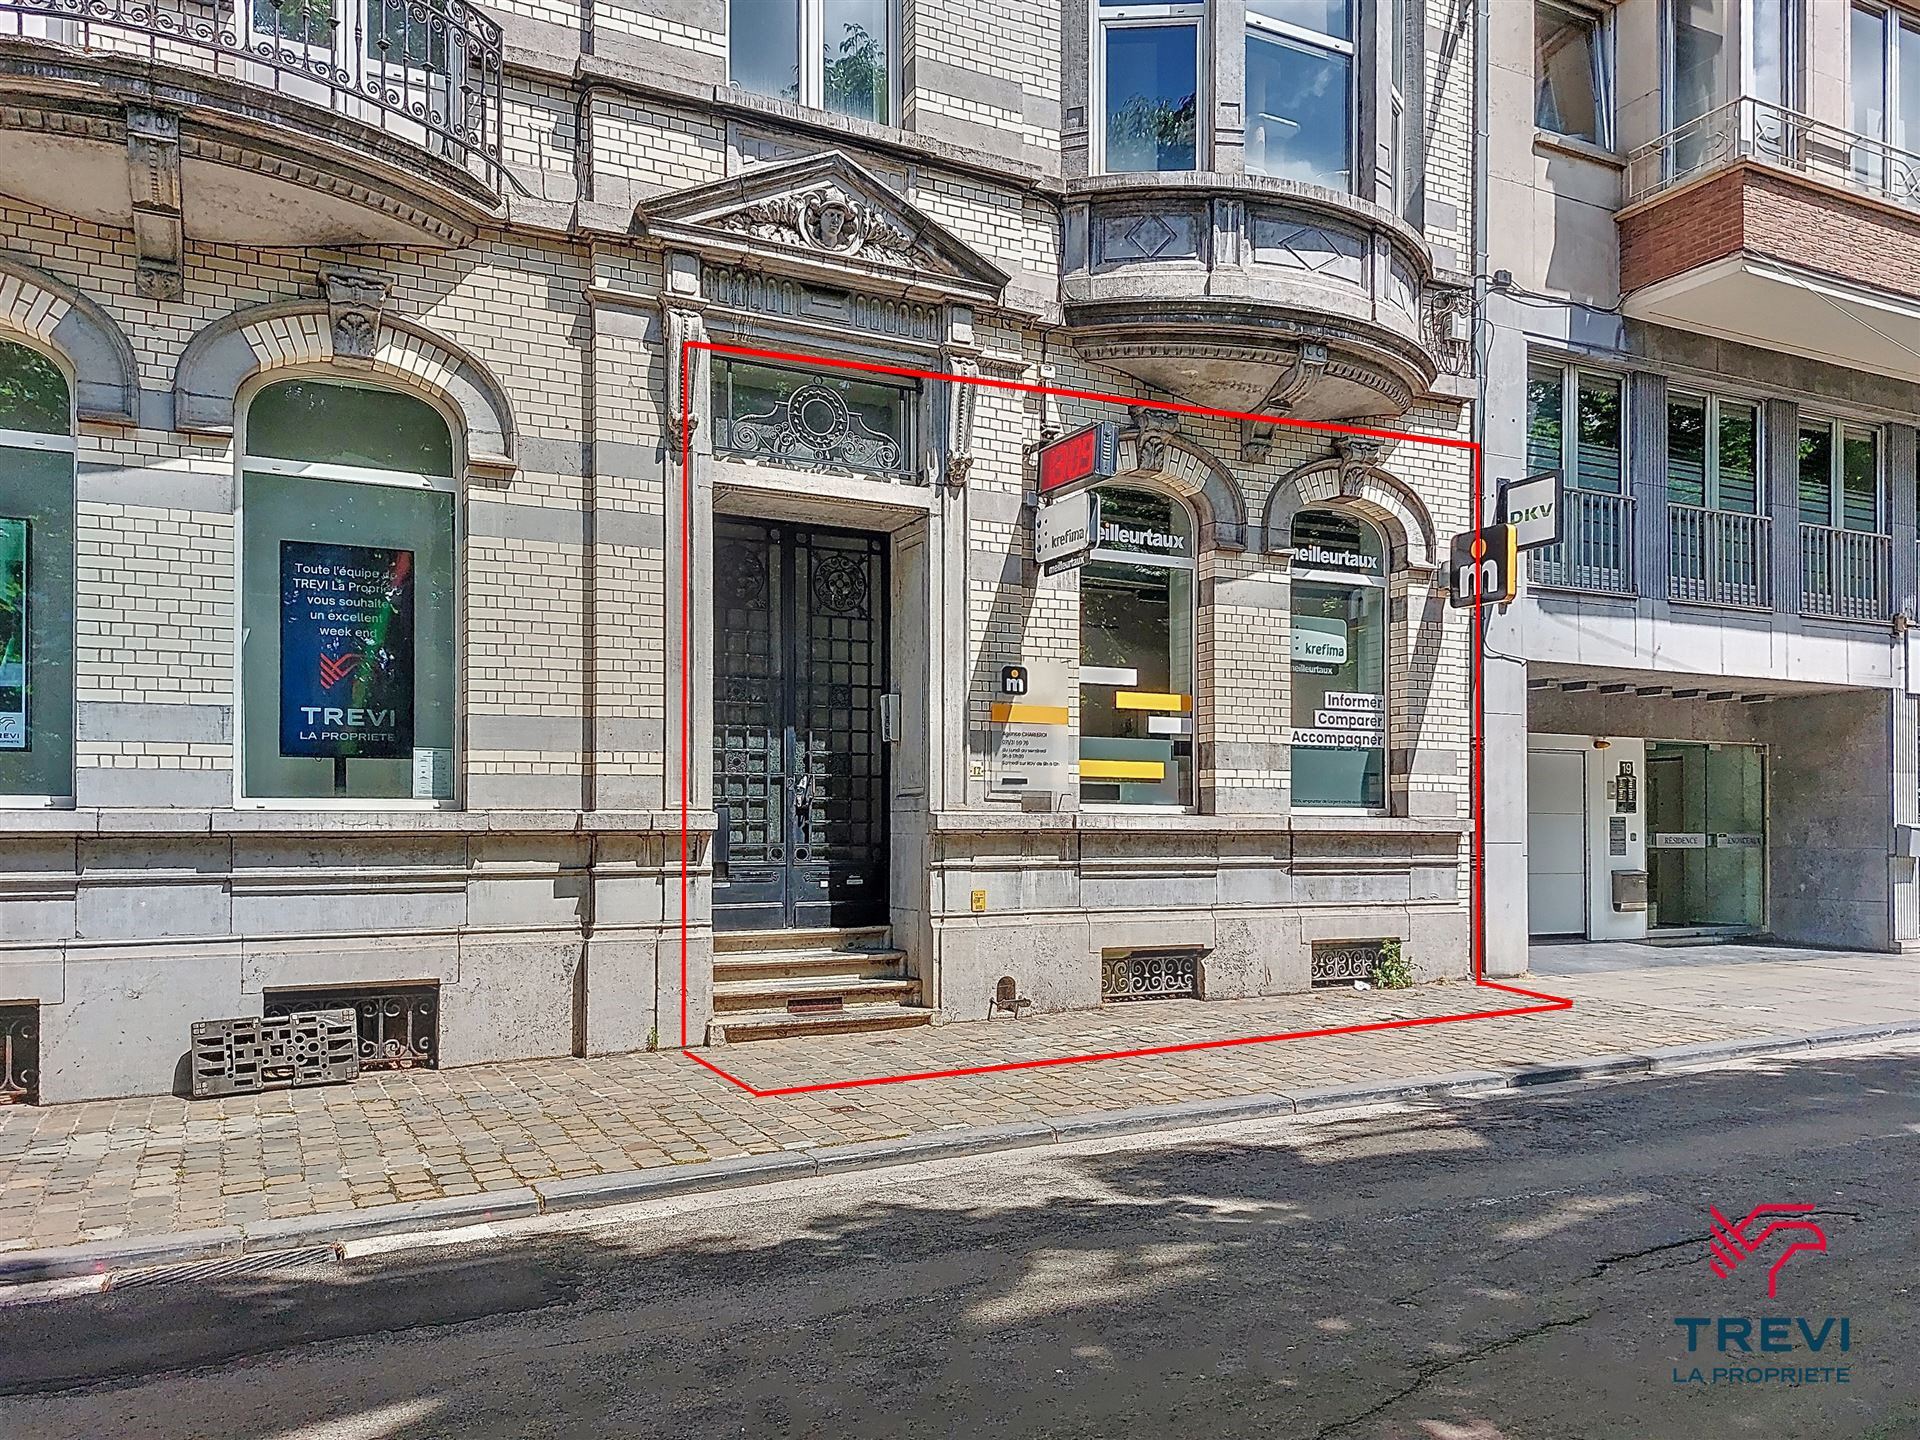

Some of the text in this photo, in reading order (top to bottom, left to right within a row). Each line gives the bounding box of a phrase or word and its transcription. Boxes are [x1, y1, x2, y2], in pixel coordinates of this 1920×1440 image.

[1510, 502, 1553, 524] DKV
[1051, 528, 1085, 549] krefima
[1100, 522, 1184, 550] eilleurtaux
[294, 563, 330, 575] Toute
[333, 566, 380, 580] l'équipe
[1048, 555, 1086, 575] meilleurtaux
[292, 577, 328, 591] TREVI
[331, 580, 346, 592] La
[306, 596, 389, 609] vous souhaite
[310, 611, 382, 624] un excellent
[319, 626, 377, 638] week end
[1305, 642, 1345, 658] krefima
[1328, 693, 1383, 708] Informer
[300, 706, 396, 727] TREVI
[1318, 712, 1383, 729] Comparer
[299, 731, 395, 742] LA PROPRIETE
[1291, 731, 1383, 747] Accompagner
[1622, 763, 1632, 774] 19
